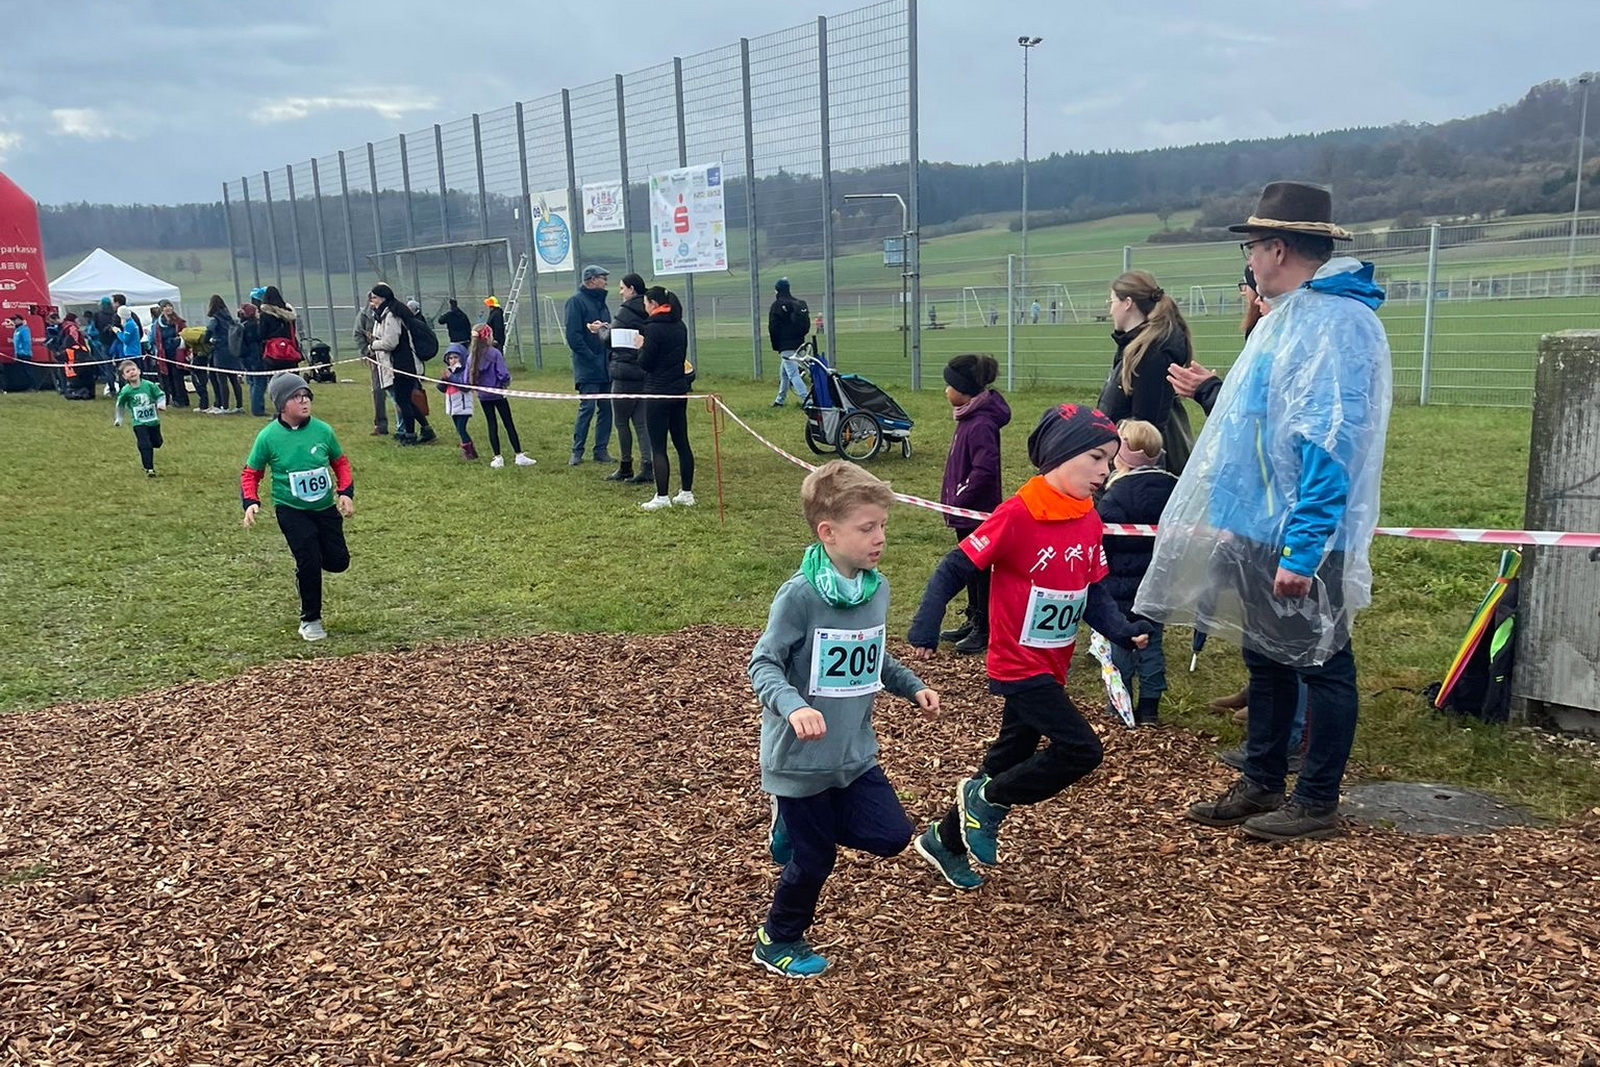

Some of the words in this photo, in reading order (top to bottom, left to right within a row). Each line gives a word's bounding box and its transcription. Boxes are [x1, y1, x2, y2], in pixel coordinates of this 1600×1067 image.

[0, 244, 37, 255] parkasse
[137, 408, 154, 418] 202
[298, 475, 327, 493] 169
[1036, 601, 1085, 631] 204
[825, 643, 878, 677] 209
